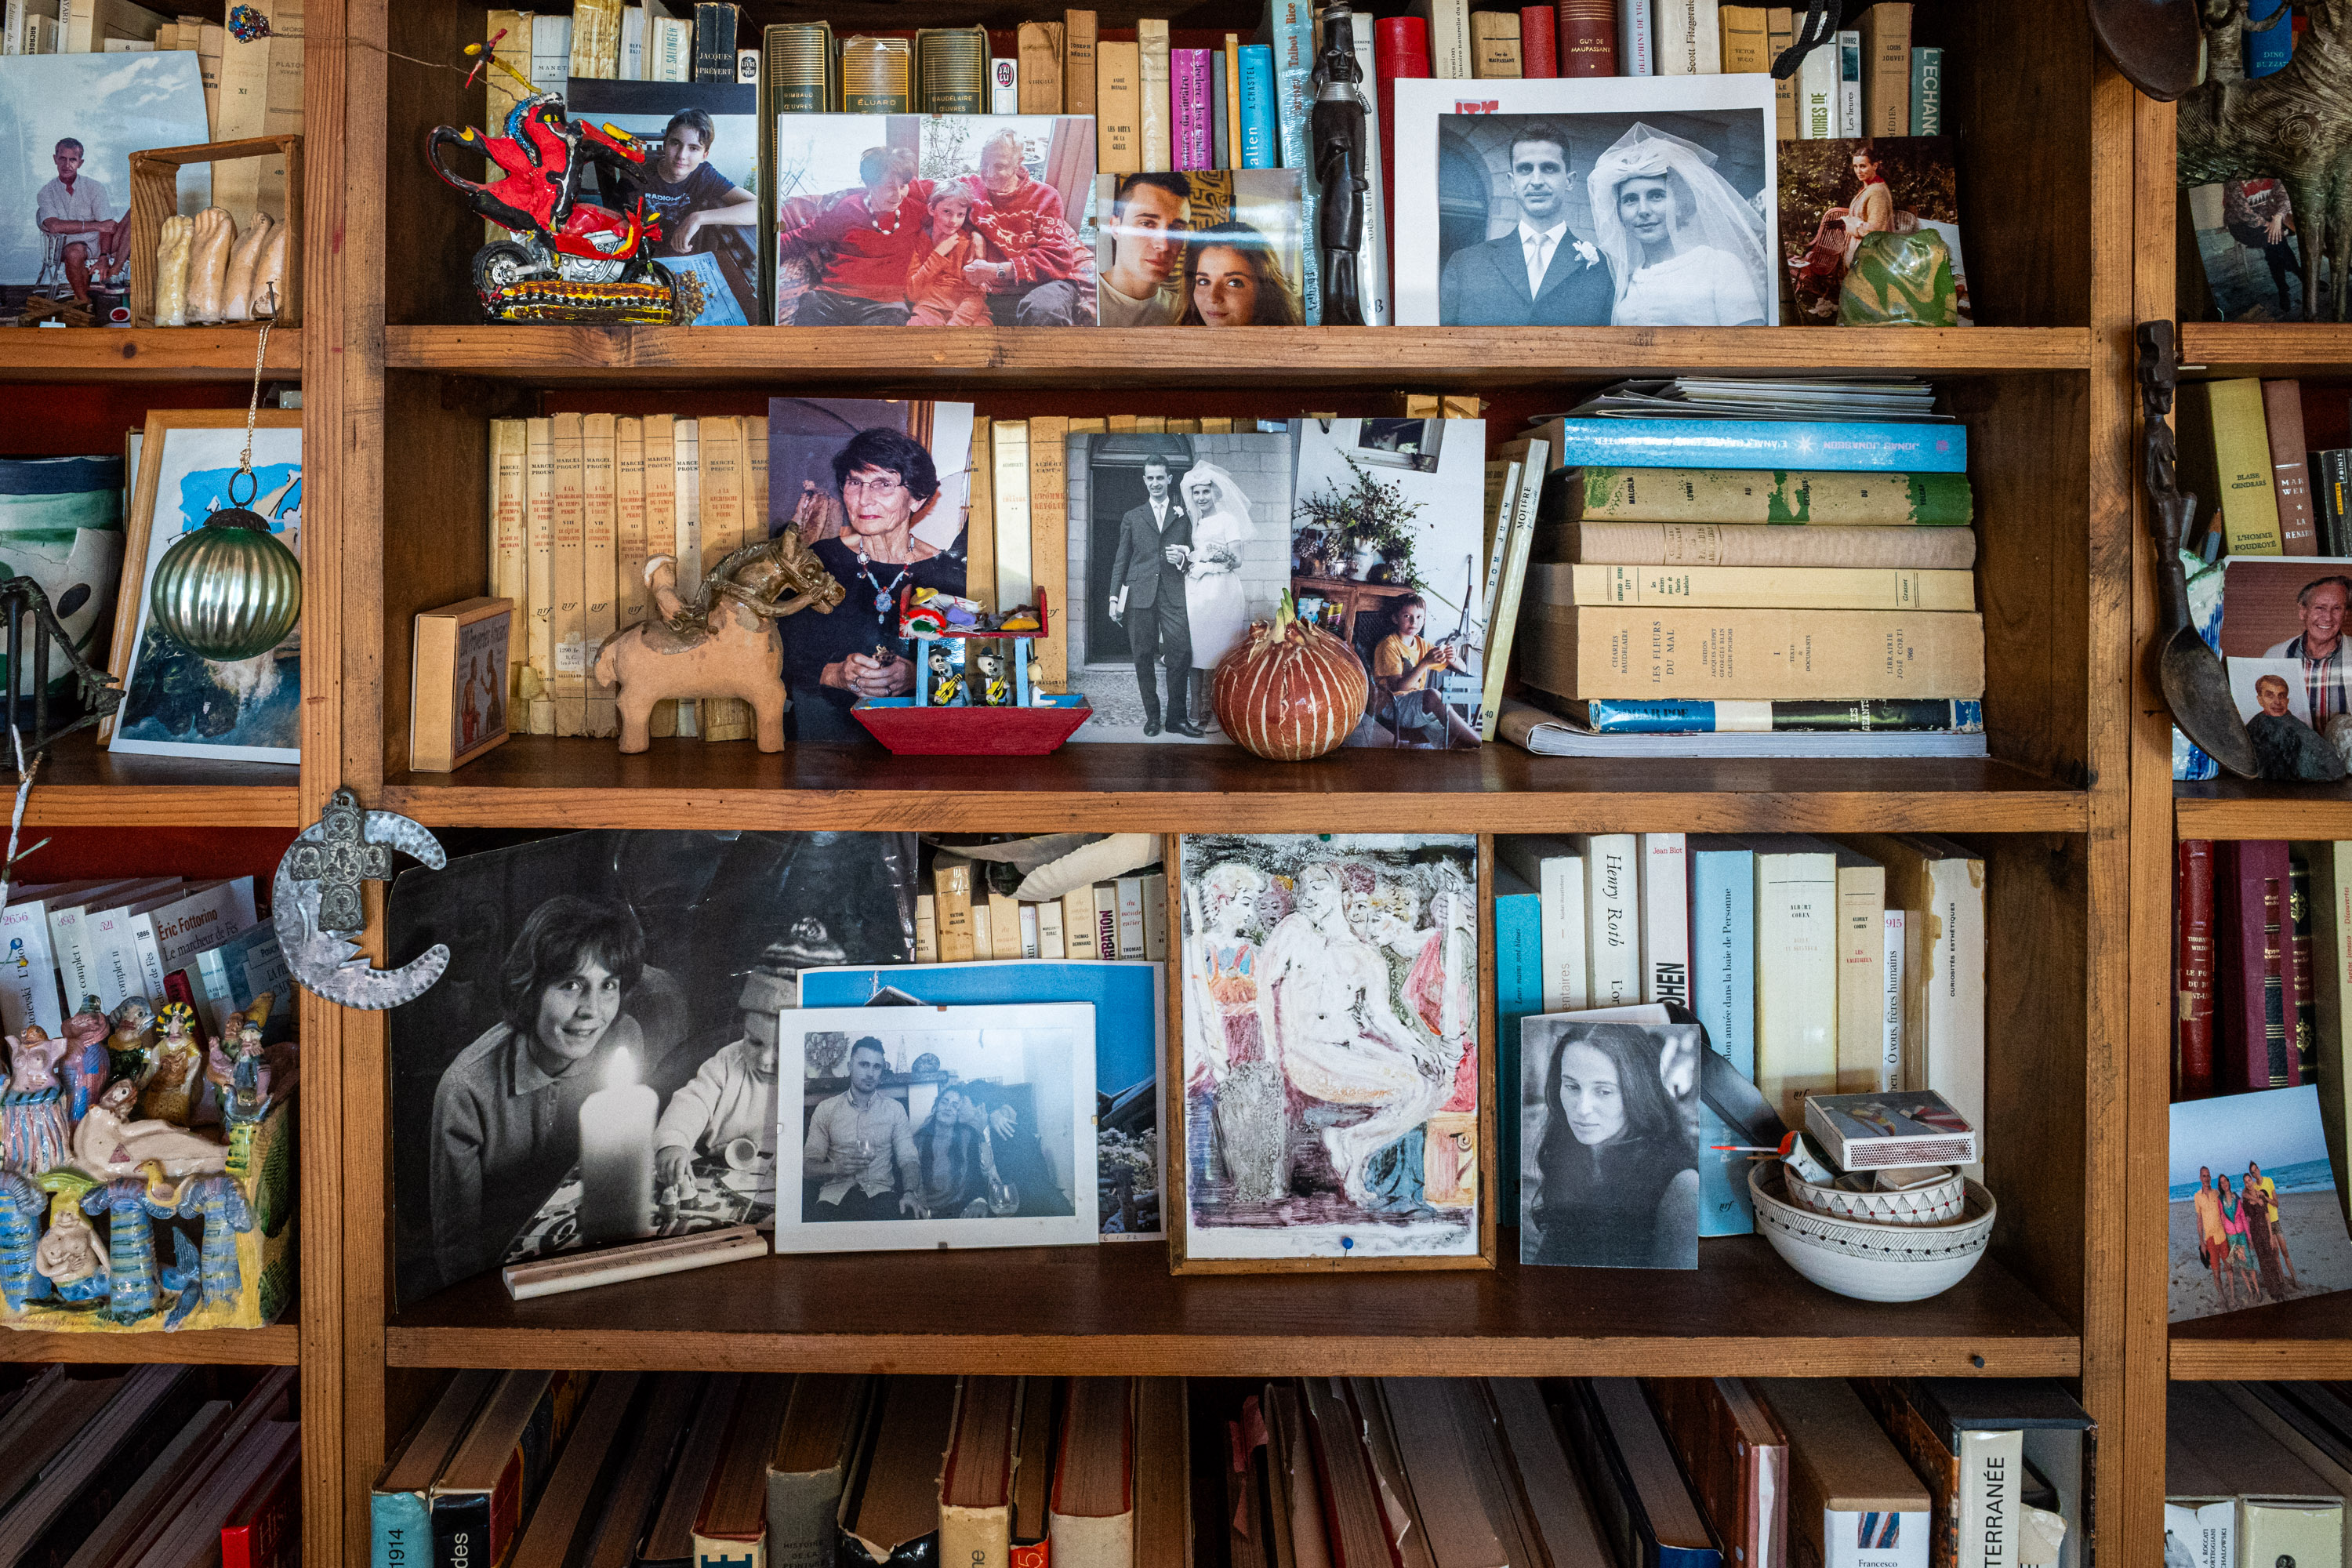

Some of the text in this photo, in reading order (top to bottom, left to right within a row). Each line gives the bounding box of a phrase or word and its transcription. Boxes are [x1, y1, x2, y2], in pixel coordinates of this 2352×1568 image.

[1286, 2, 1297, 24] Rice
[1455, 6, 1461, 15] du
[1637, 17, 1644, 30] DE
[699, 52, 732, 61] JACQUES
[1288, 34, 1299, 67] Talbot
[1687, 47, 1697, 73] Scott
[699, 67, 732, 75] PRÉVERT
[998, 65, 1010, 75] J'AI
[999, 74, 1010, 82] LU
[1247, 66, 1256, 102] CHASTEL
[858, 98, 896, 107] ÉLUARD
[1811, 93, 1828, 104] DE
[1823, 441, 1920, 451] JONAS JONASSON
[2336, 453, 2345, 481] POINTS
[2231, 480, 2267, 489] CENDRARS
[1034, 492, 1065, 500] L'HOMME
[1627, 477, 1868, 506] MALCOLM LOWRY AU DESSOUS DU
[1517, 485, 1533, 530] MOLIÈRE
[2237, 532, 2273, 542] L'HOMME
[1489, 502, 1510, 586] DOM JUAN
[2234, 540, 2277, 551] FOUDROYÉ
[536, 606, 554, 617] nrf
[561, 601, 578, 612] nrf
[590, 602, 608, 612] nrf
[628, 604, 644, 615] nrf
[1653, 621, 1661, 659] FLEURS
[1666, 659, 1675, 675] DU
[1484, 710, 1494, 719] 40
[1849, 707, 1859, 722] LES
[1602, 855, 1624, 947] Henry Roth
[2, 912, 29, 926] 2656
[57, 914, 75, 927] 393
[158, 909, 218, 942] Éric Fottorino
[100, 920, 114, 932] 521
[136, 930, 150, 938] 5886
[162, 925, 226, 962] Le marcheur de
[72, 952, 88, 989] complet
[146, 951, 158, 978] de Fès
[1722, 887, 1732, 1044] année dans la baie de Personne
[112, 960, 126, 997] complet
[1884, 950, 1898, 1063] Ô vous, frères humains
[1984, 1457, 2004, 1568] TERRANÉE
[783, 1540, 824, 1548] HISTOIRE
[1857, 1559, 1898, 1568] Francesco
